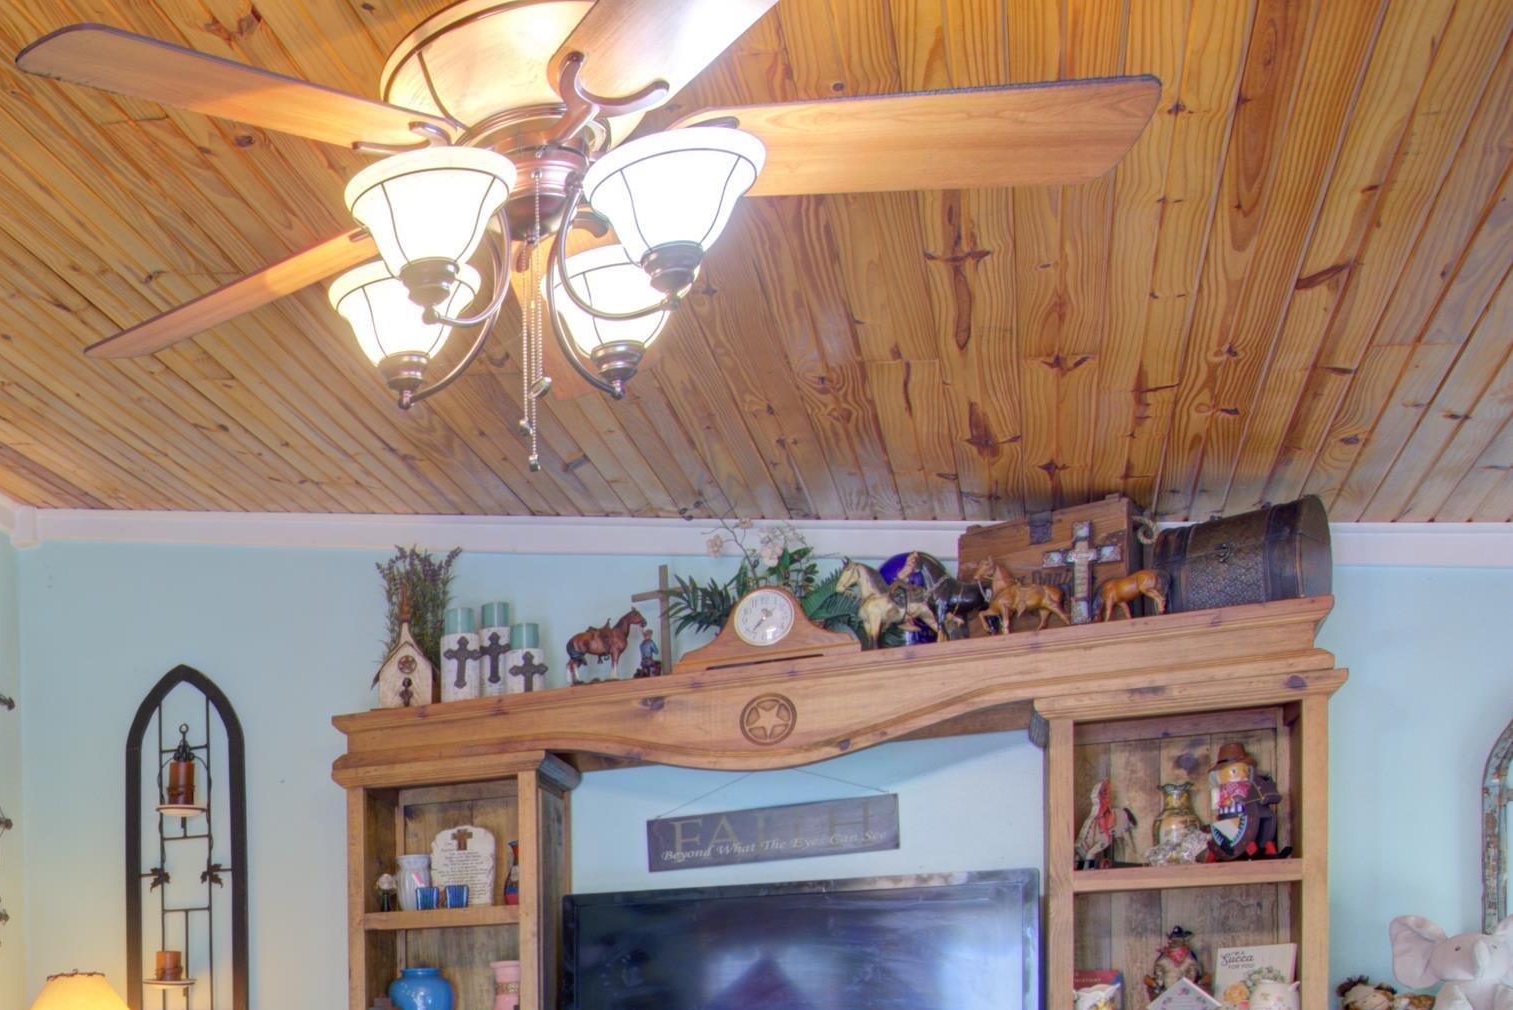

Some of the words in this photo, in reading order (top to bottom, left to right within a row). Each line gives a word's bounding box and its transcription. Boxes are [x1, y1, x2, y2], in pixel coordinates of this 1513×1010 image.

[661, 844, 713, 863] Beyond
[716, 841, 756, 856] What
[759, 837, 786, 852] The
[790, 834, 824, 850] Eyes
[829, 832, 858, 847] Can
[863, 829, 888, 843] See
[668, 801, 874, 862] FAITH
